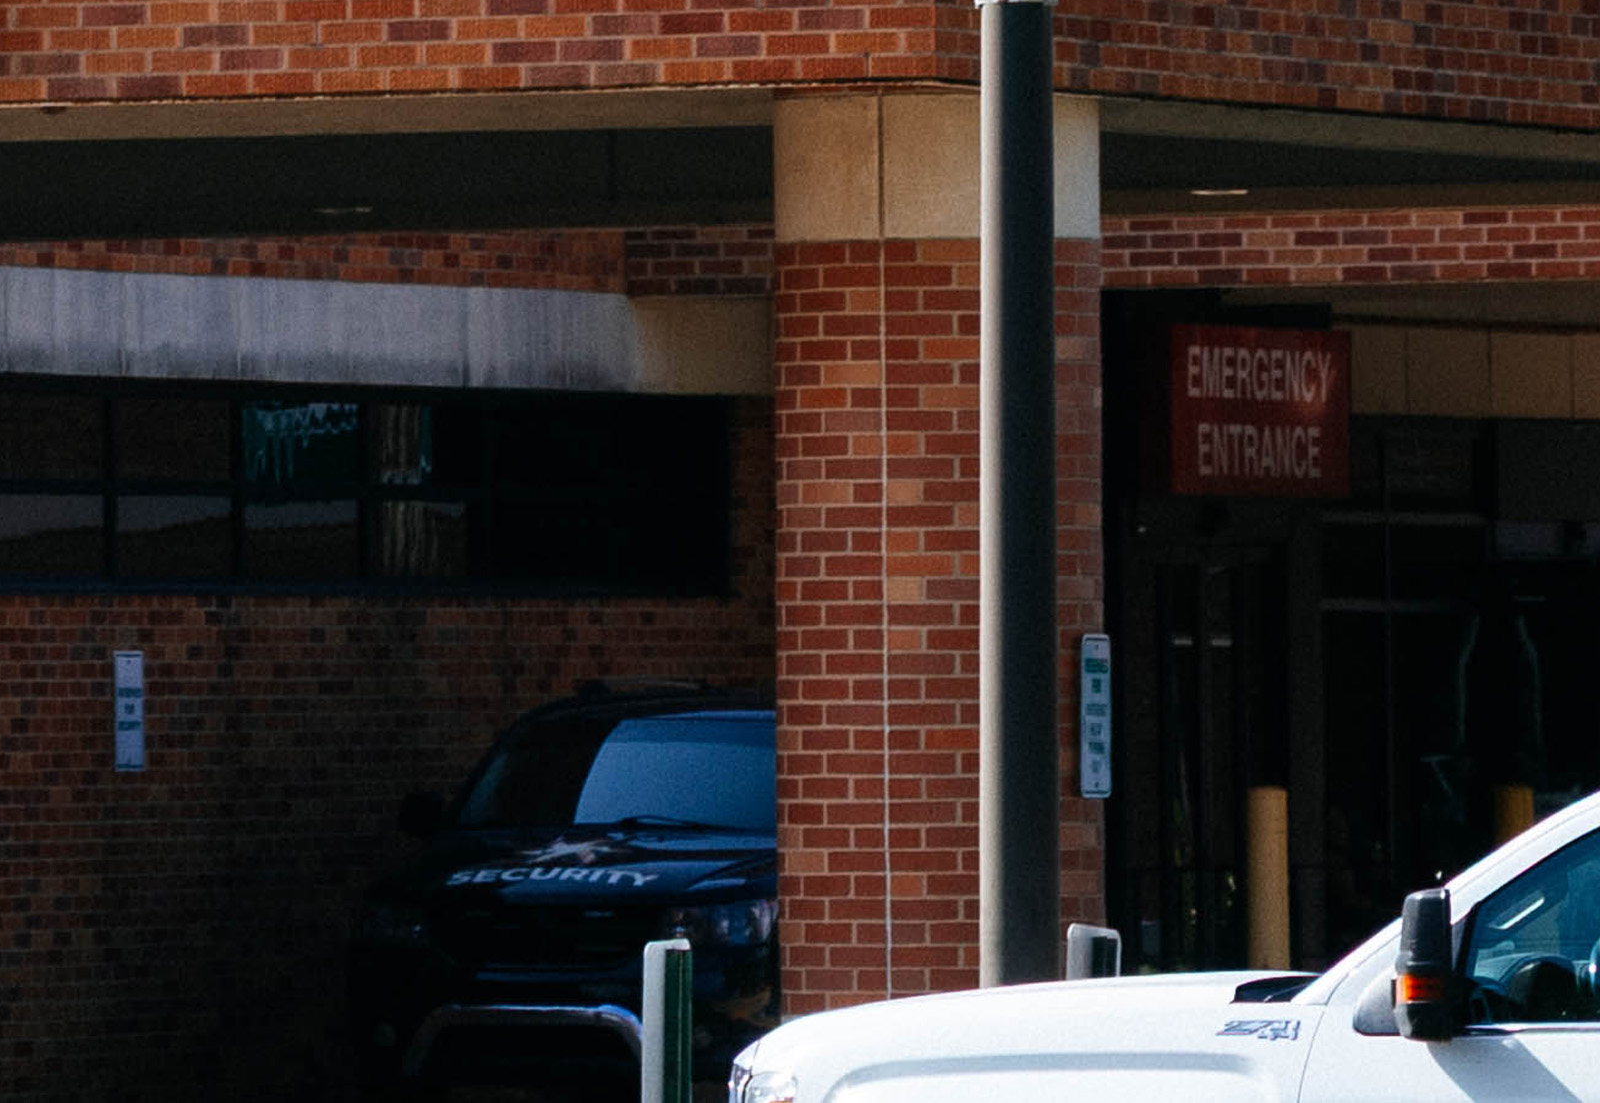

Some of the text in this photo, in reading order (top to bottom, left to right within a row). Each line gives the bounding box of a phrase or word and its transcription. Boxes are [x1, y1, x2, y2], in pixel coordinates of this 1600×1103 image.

[1186, 344, 1332, 403] EMERGENCY
[1198, 421, 1322, 479] ENTRANCE
[445, 866, 659, 887] SECURITY
